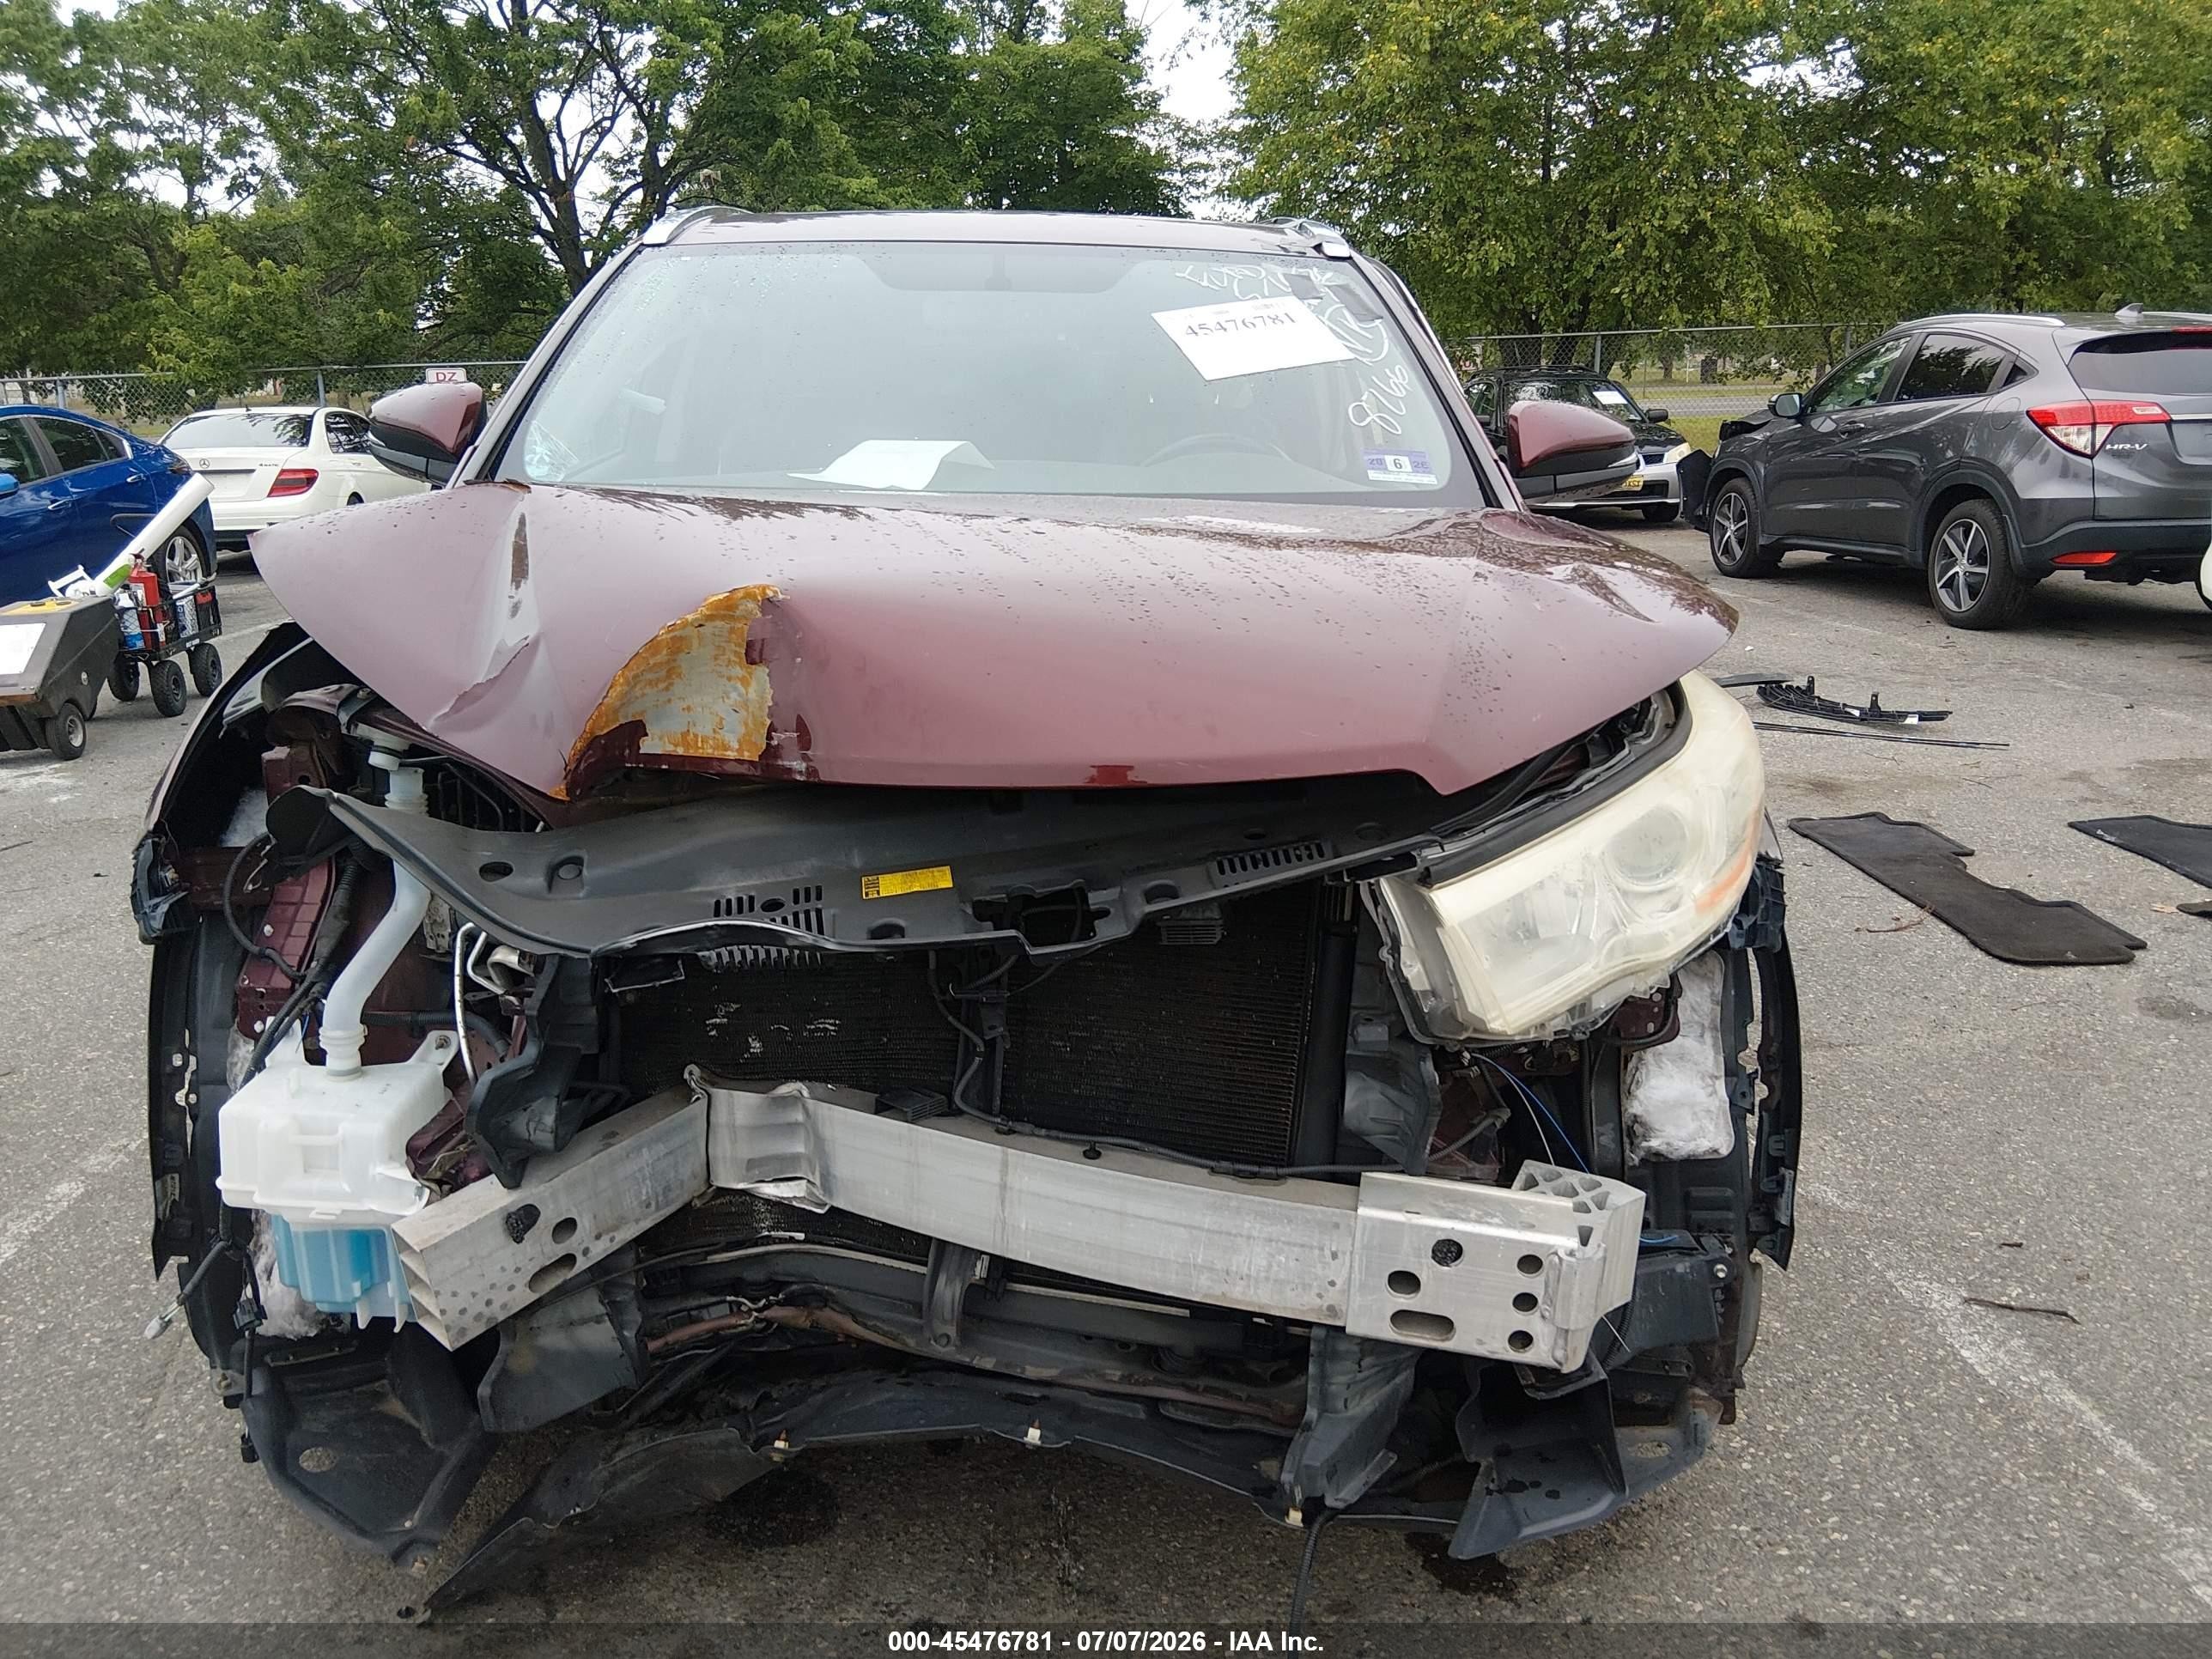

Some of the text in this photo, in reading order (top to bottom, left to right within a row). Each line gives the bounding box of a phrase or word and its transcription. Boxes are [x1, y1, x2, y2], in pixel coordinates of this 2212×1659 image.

[1185, 313, 1296, 337] 45476781
[435, 372, 459, 382] DZ
[2105, 442, 2148, 453] HR-V
[1393, 458, 1403, 470] 6
